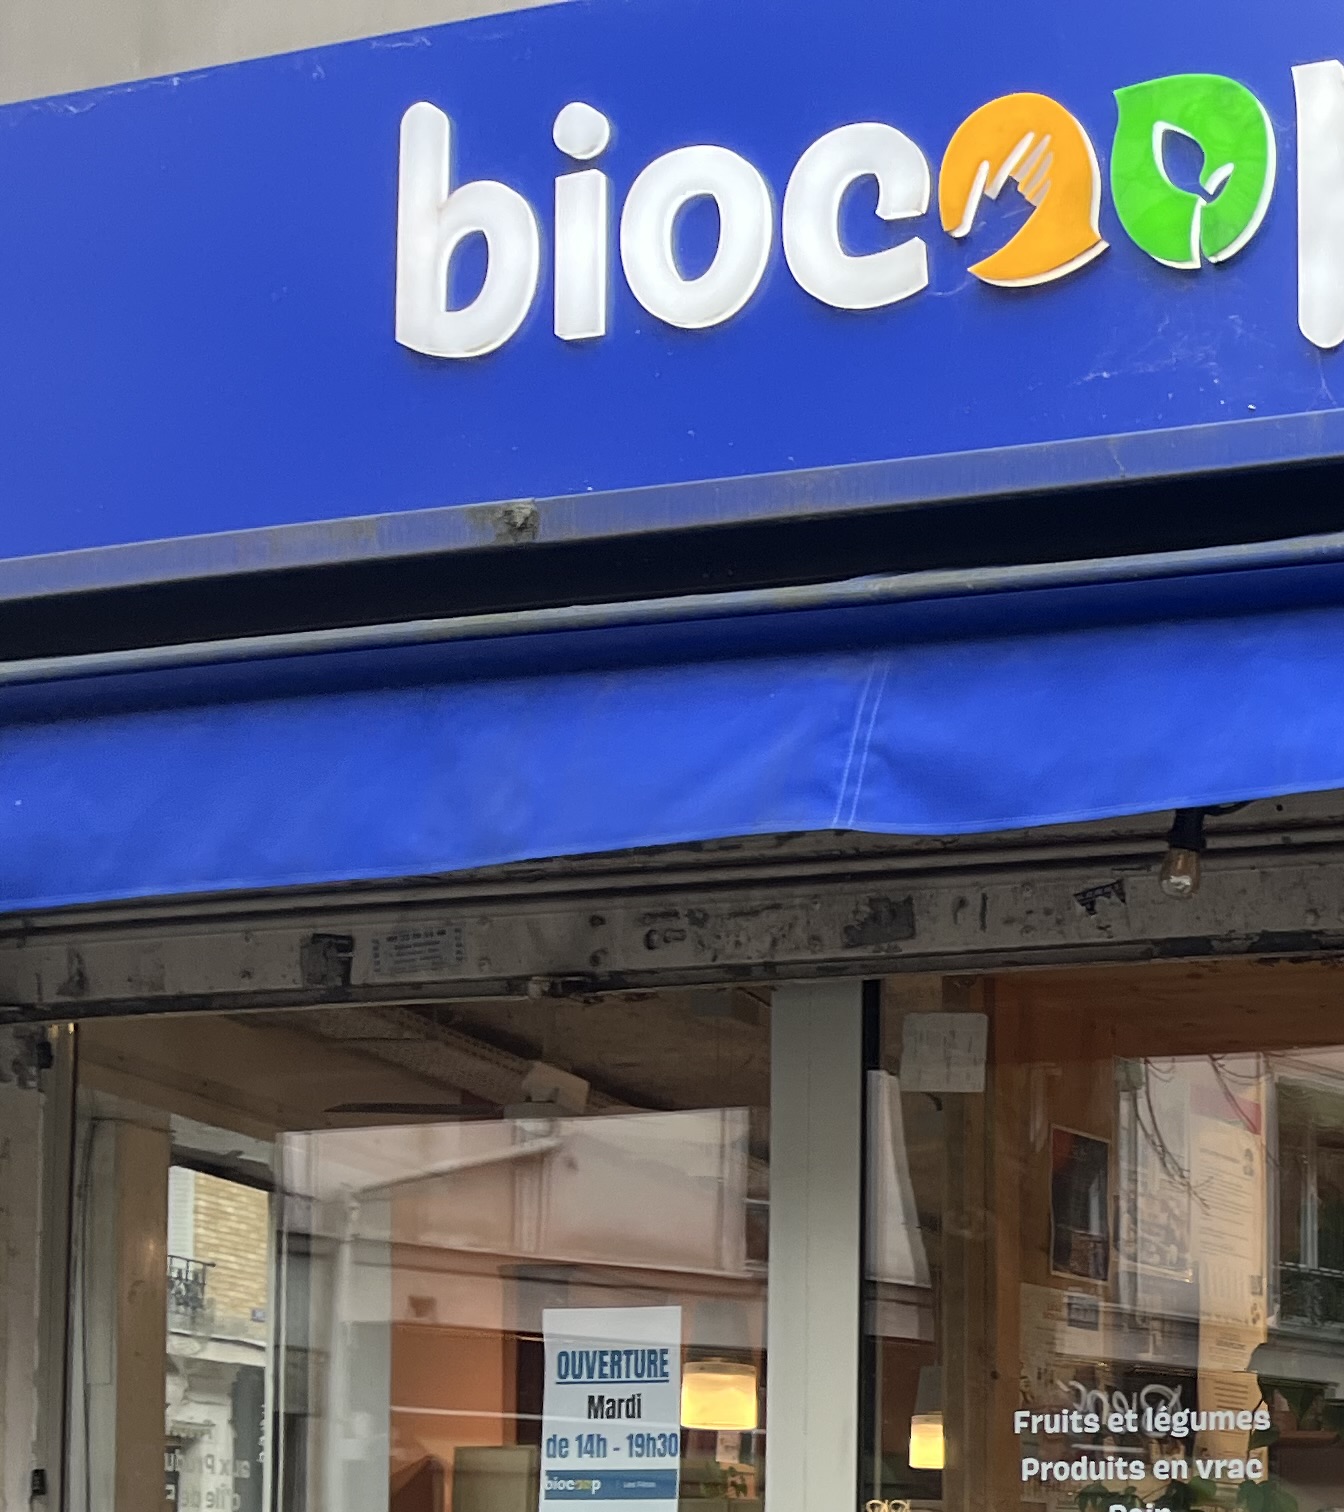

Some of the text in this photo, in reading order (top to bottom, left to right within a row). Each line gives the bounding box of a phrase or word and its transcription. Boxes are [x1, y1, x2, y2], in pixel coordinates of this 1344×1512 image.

[557, 1348, 670, 1381] OUVERTURE
[587, 1393, 642, 1420] Mardi
[1013, 1410, 1100, 1435] Fruits
[1106, 1411, 1138, 1434] et
[1145, 1405, 1271, 1438] légumes
[546, 1434, 569, 1459] de
[575, 1433, 607, 1459] 14h
[626, 1432, 679, 1459] 19h30
[1021, 1456, 1264, 1482] Produits en vrac
